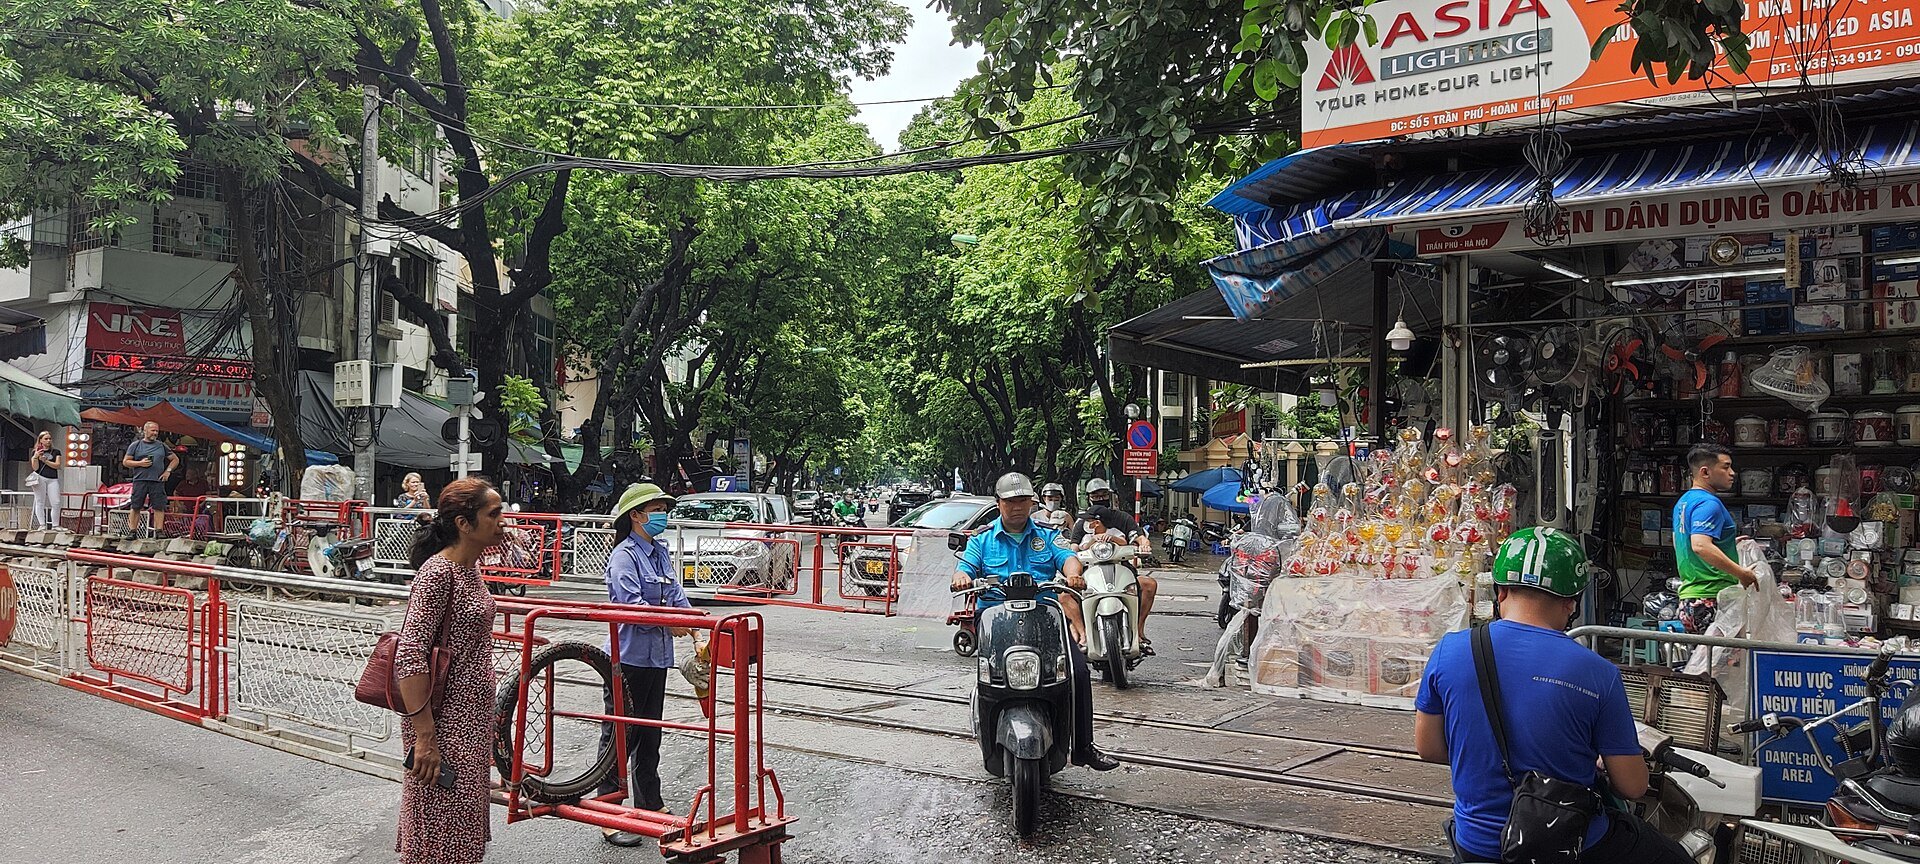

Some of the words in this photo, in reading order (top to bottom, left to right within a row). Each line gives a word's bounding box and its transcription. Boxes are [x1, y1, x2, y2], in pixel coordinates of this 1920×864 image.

[1381, 0, 1551, 49] ASIA
[1745, 29, 1770, 50] ƠM
[1829, 17, 1859, 38] LED
[1868, 8, 1913, 32] ASIA
[1390, 34, 1543, 75] LIGHTING
[1771, 63, 1791, 75] ĐT:
[1795, 56, 1827, 71] 0936
[1316, 93, 1367, 113] YOUR
[1490, 61, 1553, 86] LIGHT
[1391, 121, 1407, 132] ĐC:
[1433, 110, 1459, 125] TRẦN
[1559, 94, 1573, 106] HN
[1605, 201, 1669, 231] DÂN
[1680, 195, 1770, 229] DỤNG
[1782, 187, 1878, 217] OANH
[1464, 239, 1474, 248] HÀ
[1475, 237, 1488, 247] NỘI
[1748, 247, 1781, 255] MISUKO
[1775, 670, 1802, 688] KHU
[1806, 671, 1833, 693] VỰC
[1762, 695, 1798, 713] NGUY
[1802, 692, 1836, 715] HIỂM
[1782, 768, 1813, 783] AREA
